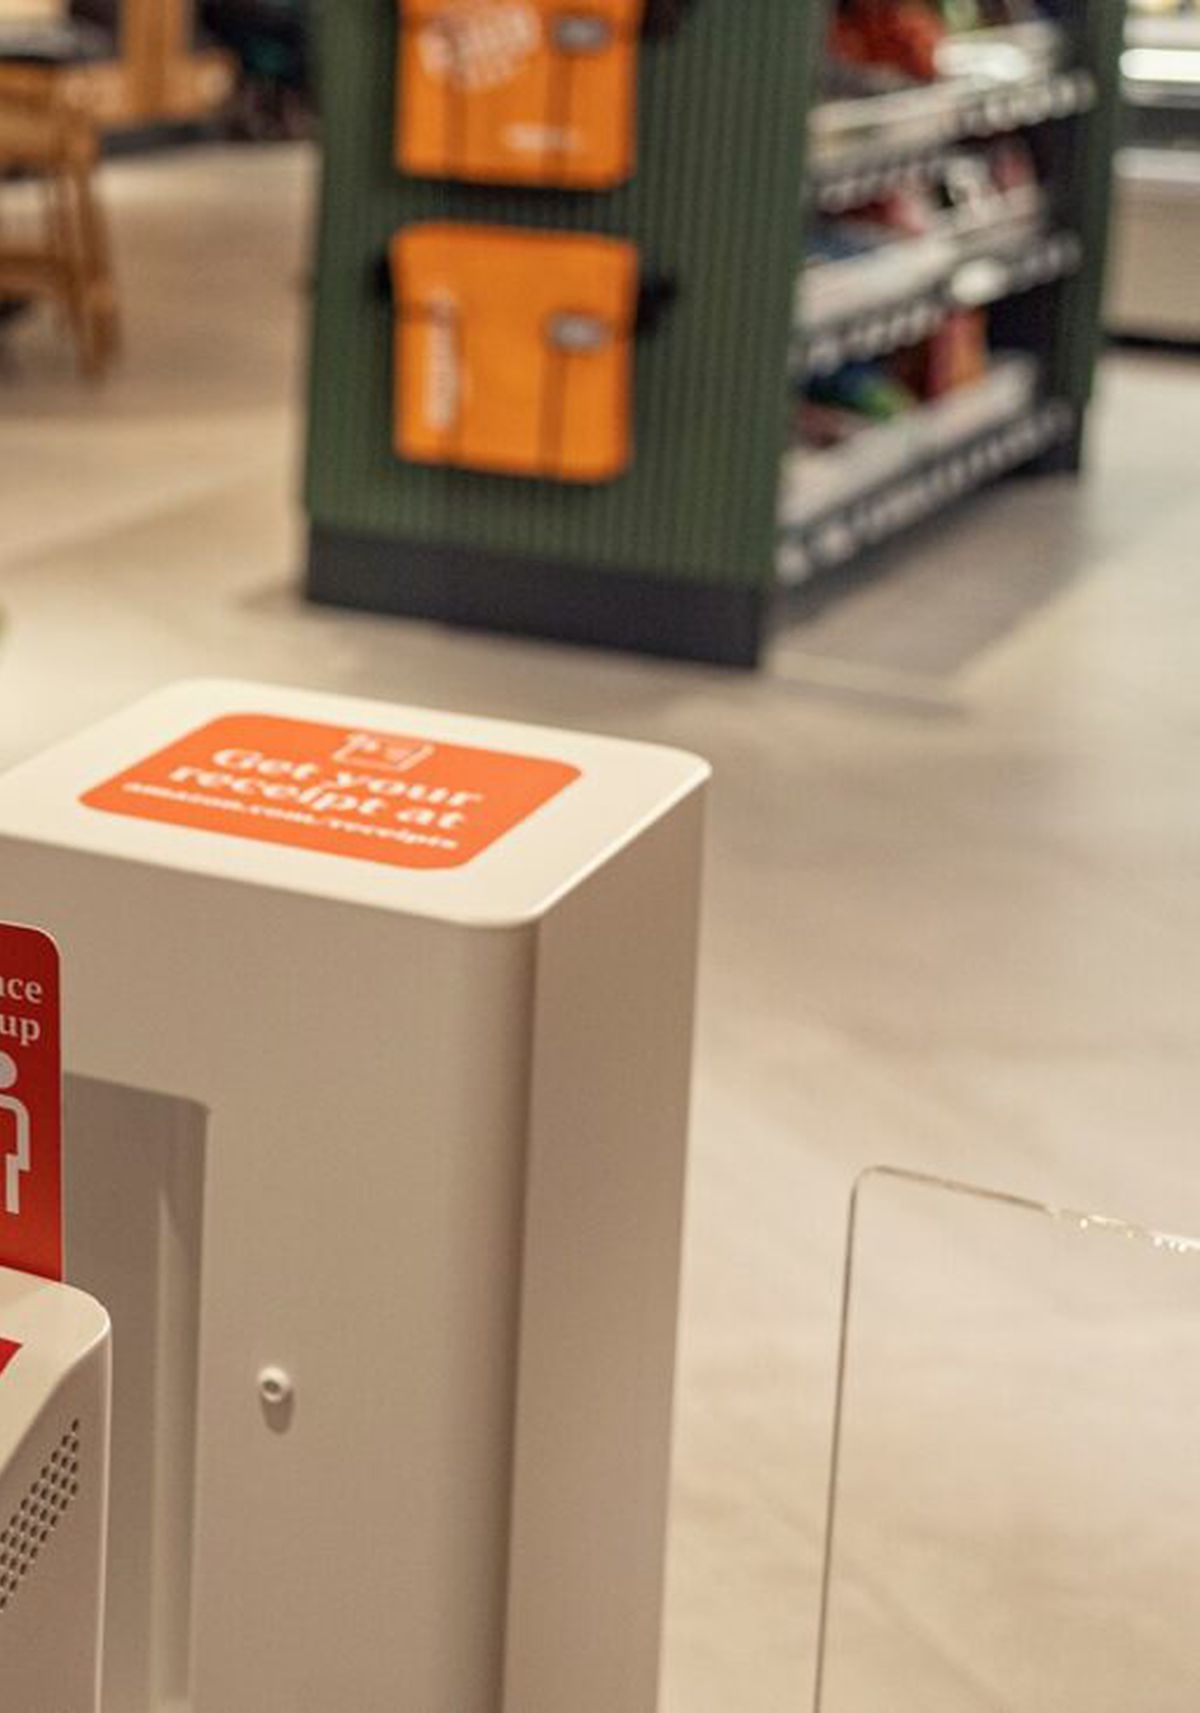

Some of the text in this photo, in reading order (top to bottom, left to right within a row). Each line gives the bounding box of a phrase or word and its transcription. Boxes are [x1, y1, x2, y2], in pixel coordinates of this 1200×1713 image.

[169, 766, 464, 829] receipt at
[213, 749, 484, 806] Get your
